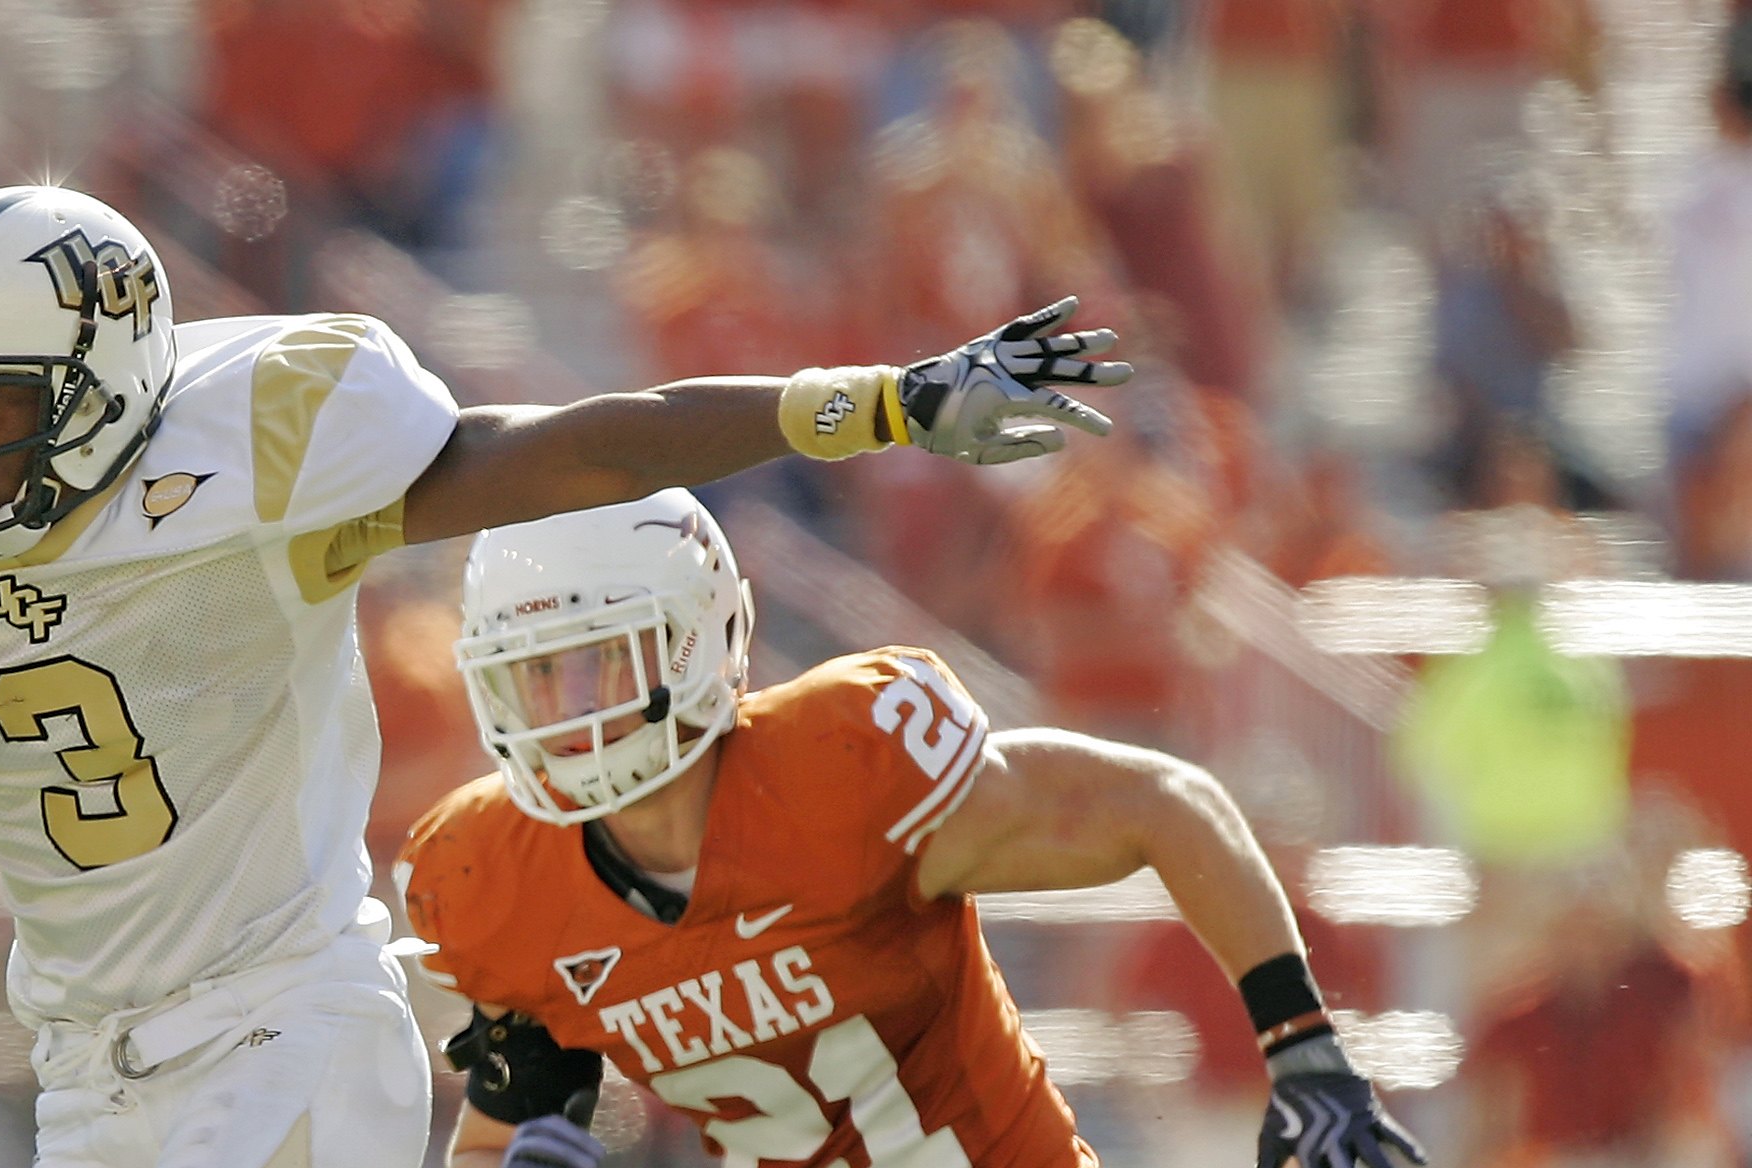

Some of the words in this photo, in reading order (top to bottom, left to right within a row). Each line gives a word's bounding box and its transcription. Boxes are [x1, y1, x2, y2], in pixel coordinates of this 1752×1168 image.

[21, 227, 160, 342] UCF
[815, 391, 855, 435] UCF
[515, 597, 560, 616] HORNS
[872, 656, 974, 780] 21
[599, 944, 836, 1073] TEXAS
